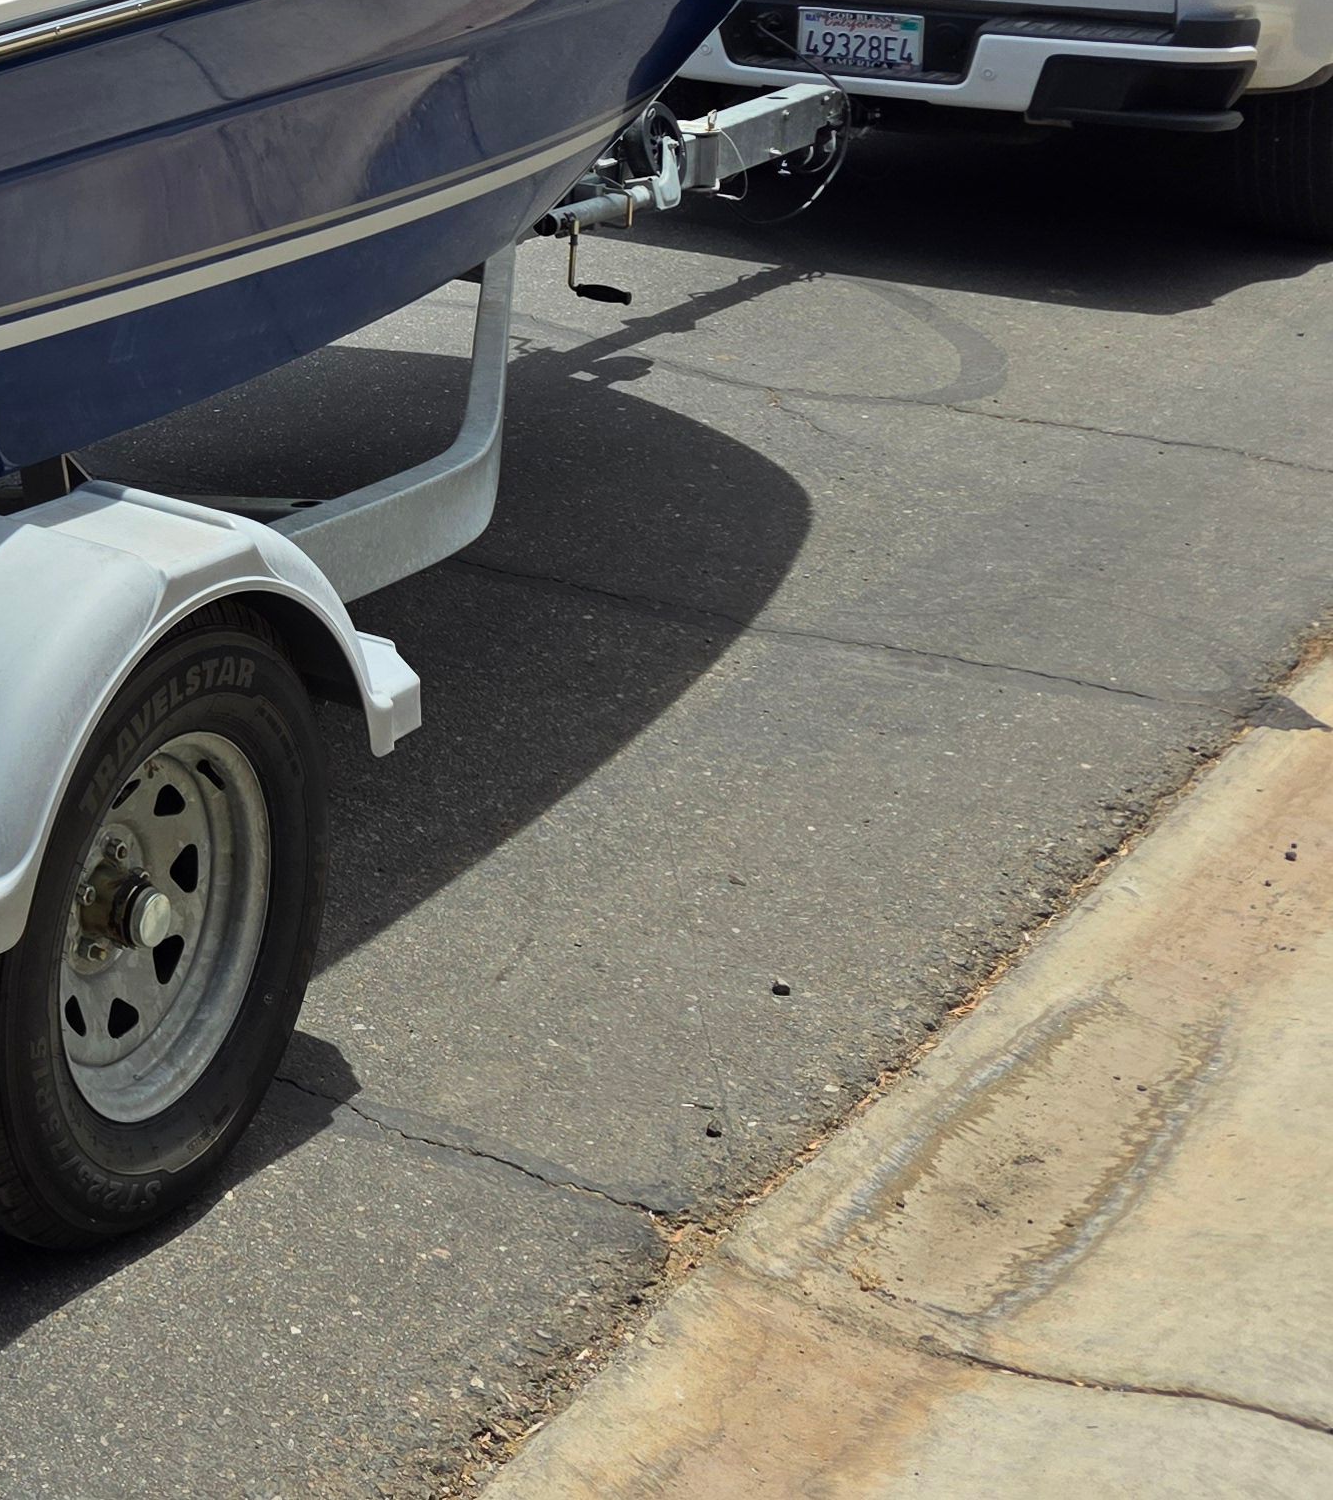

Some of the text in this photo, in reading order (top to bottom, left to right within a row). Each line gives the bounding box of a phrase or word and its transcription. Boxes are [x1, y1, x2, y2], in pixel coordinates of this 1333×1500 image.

[824, 17, 901, 32] California
[828, 11, 893, 23] GOD BLESS
[805, 30, 913, 63] 49328E4
[827, 57, 889, 69] AMERICA
[78, 656, 257, 818] TRAVELSTAR
